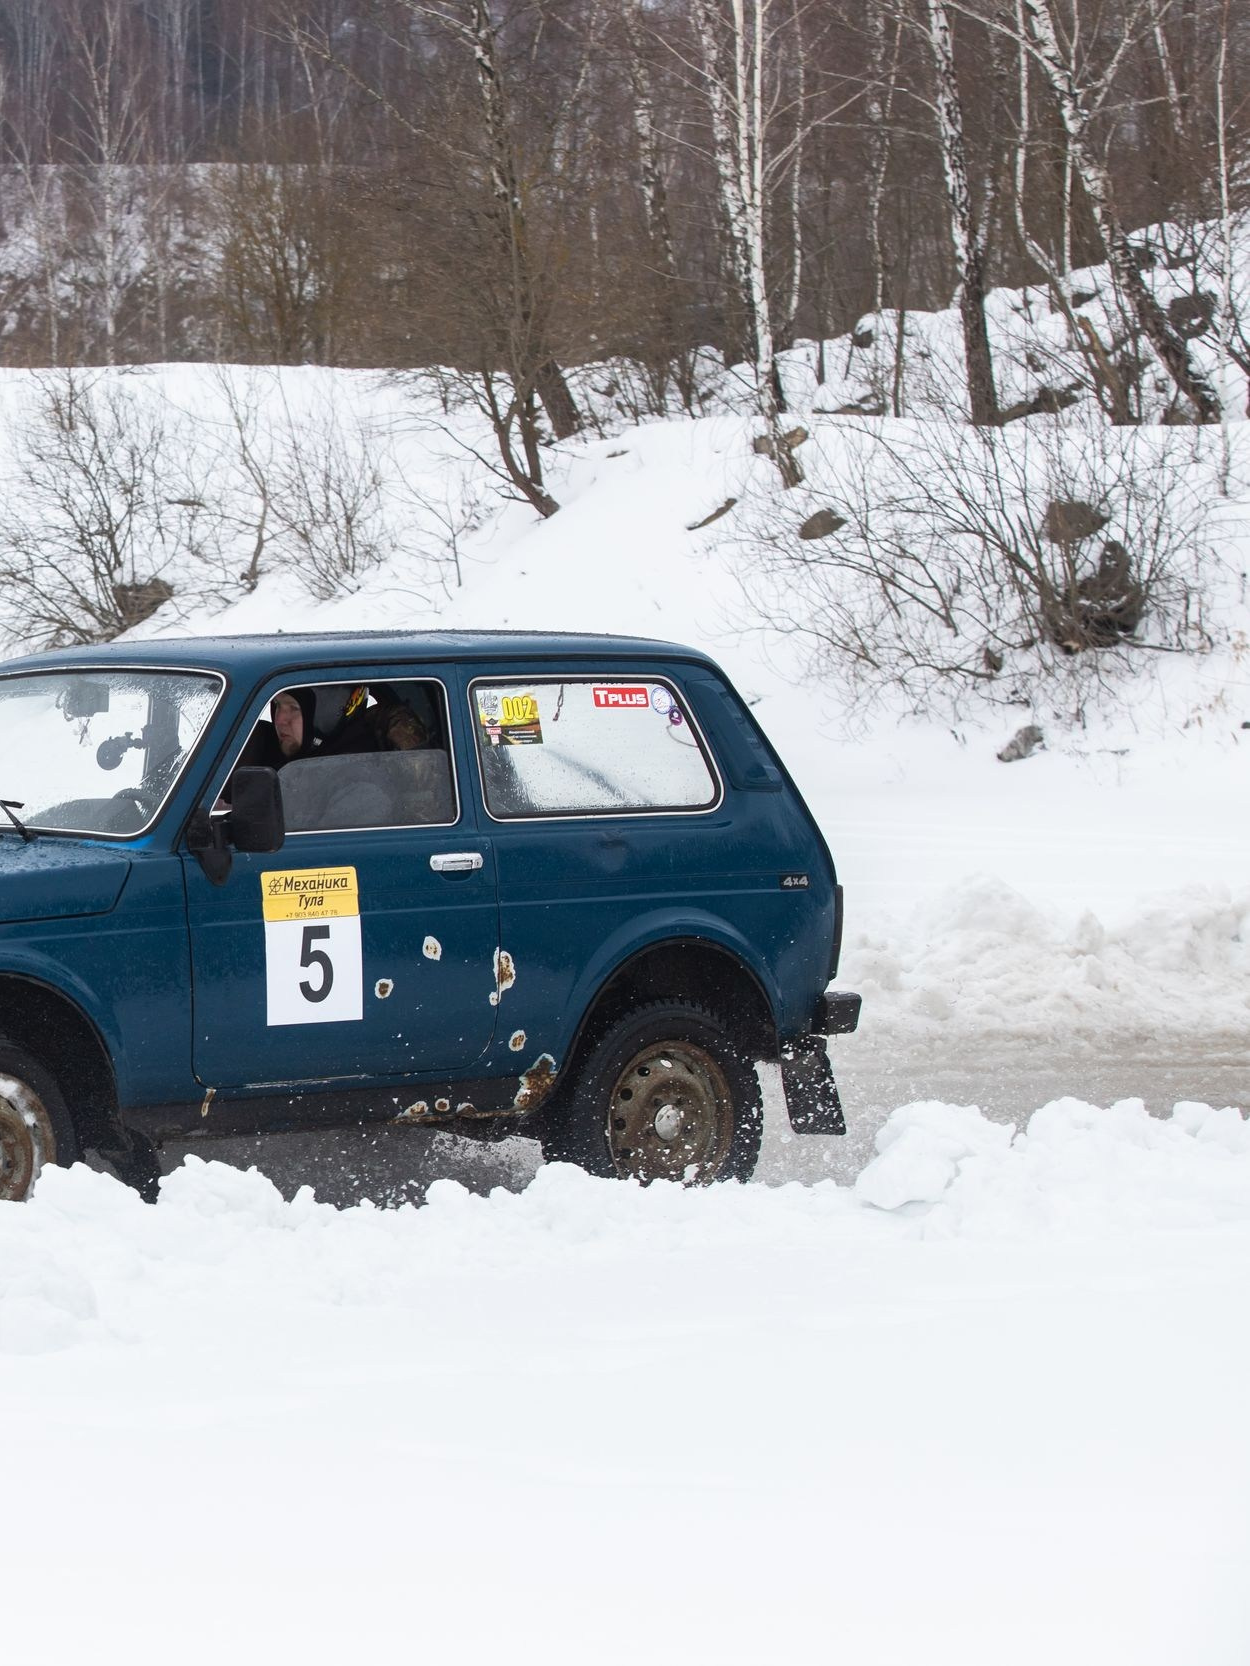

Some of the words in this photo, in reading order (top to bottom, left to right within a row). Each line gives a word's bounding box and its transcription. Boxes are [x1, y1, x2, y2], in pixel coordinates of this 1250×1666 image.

[595, 690, 647, 705] TPLUS
[501, 696, 535, 720] 002
[283, 876, 348, 892] Механика
[783, 875, 809, 887] 4x4
[298, 894, 324, 910] Тула
[299, 925, 334, 1003] 5
